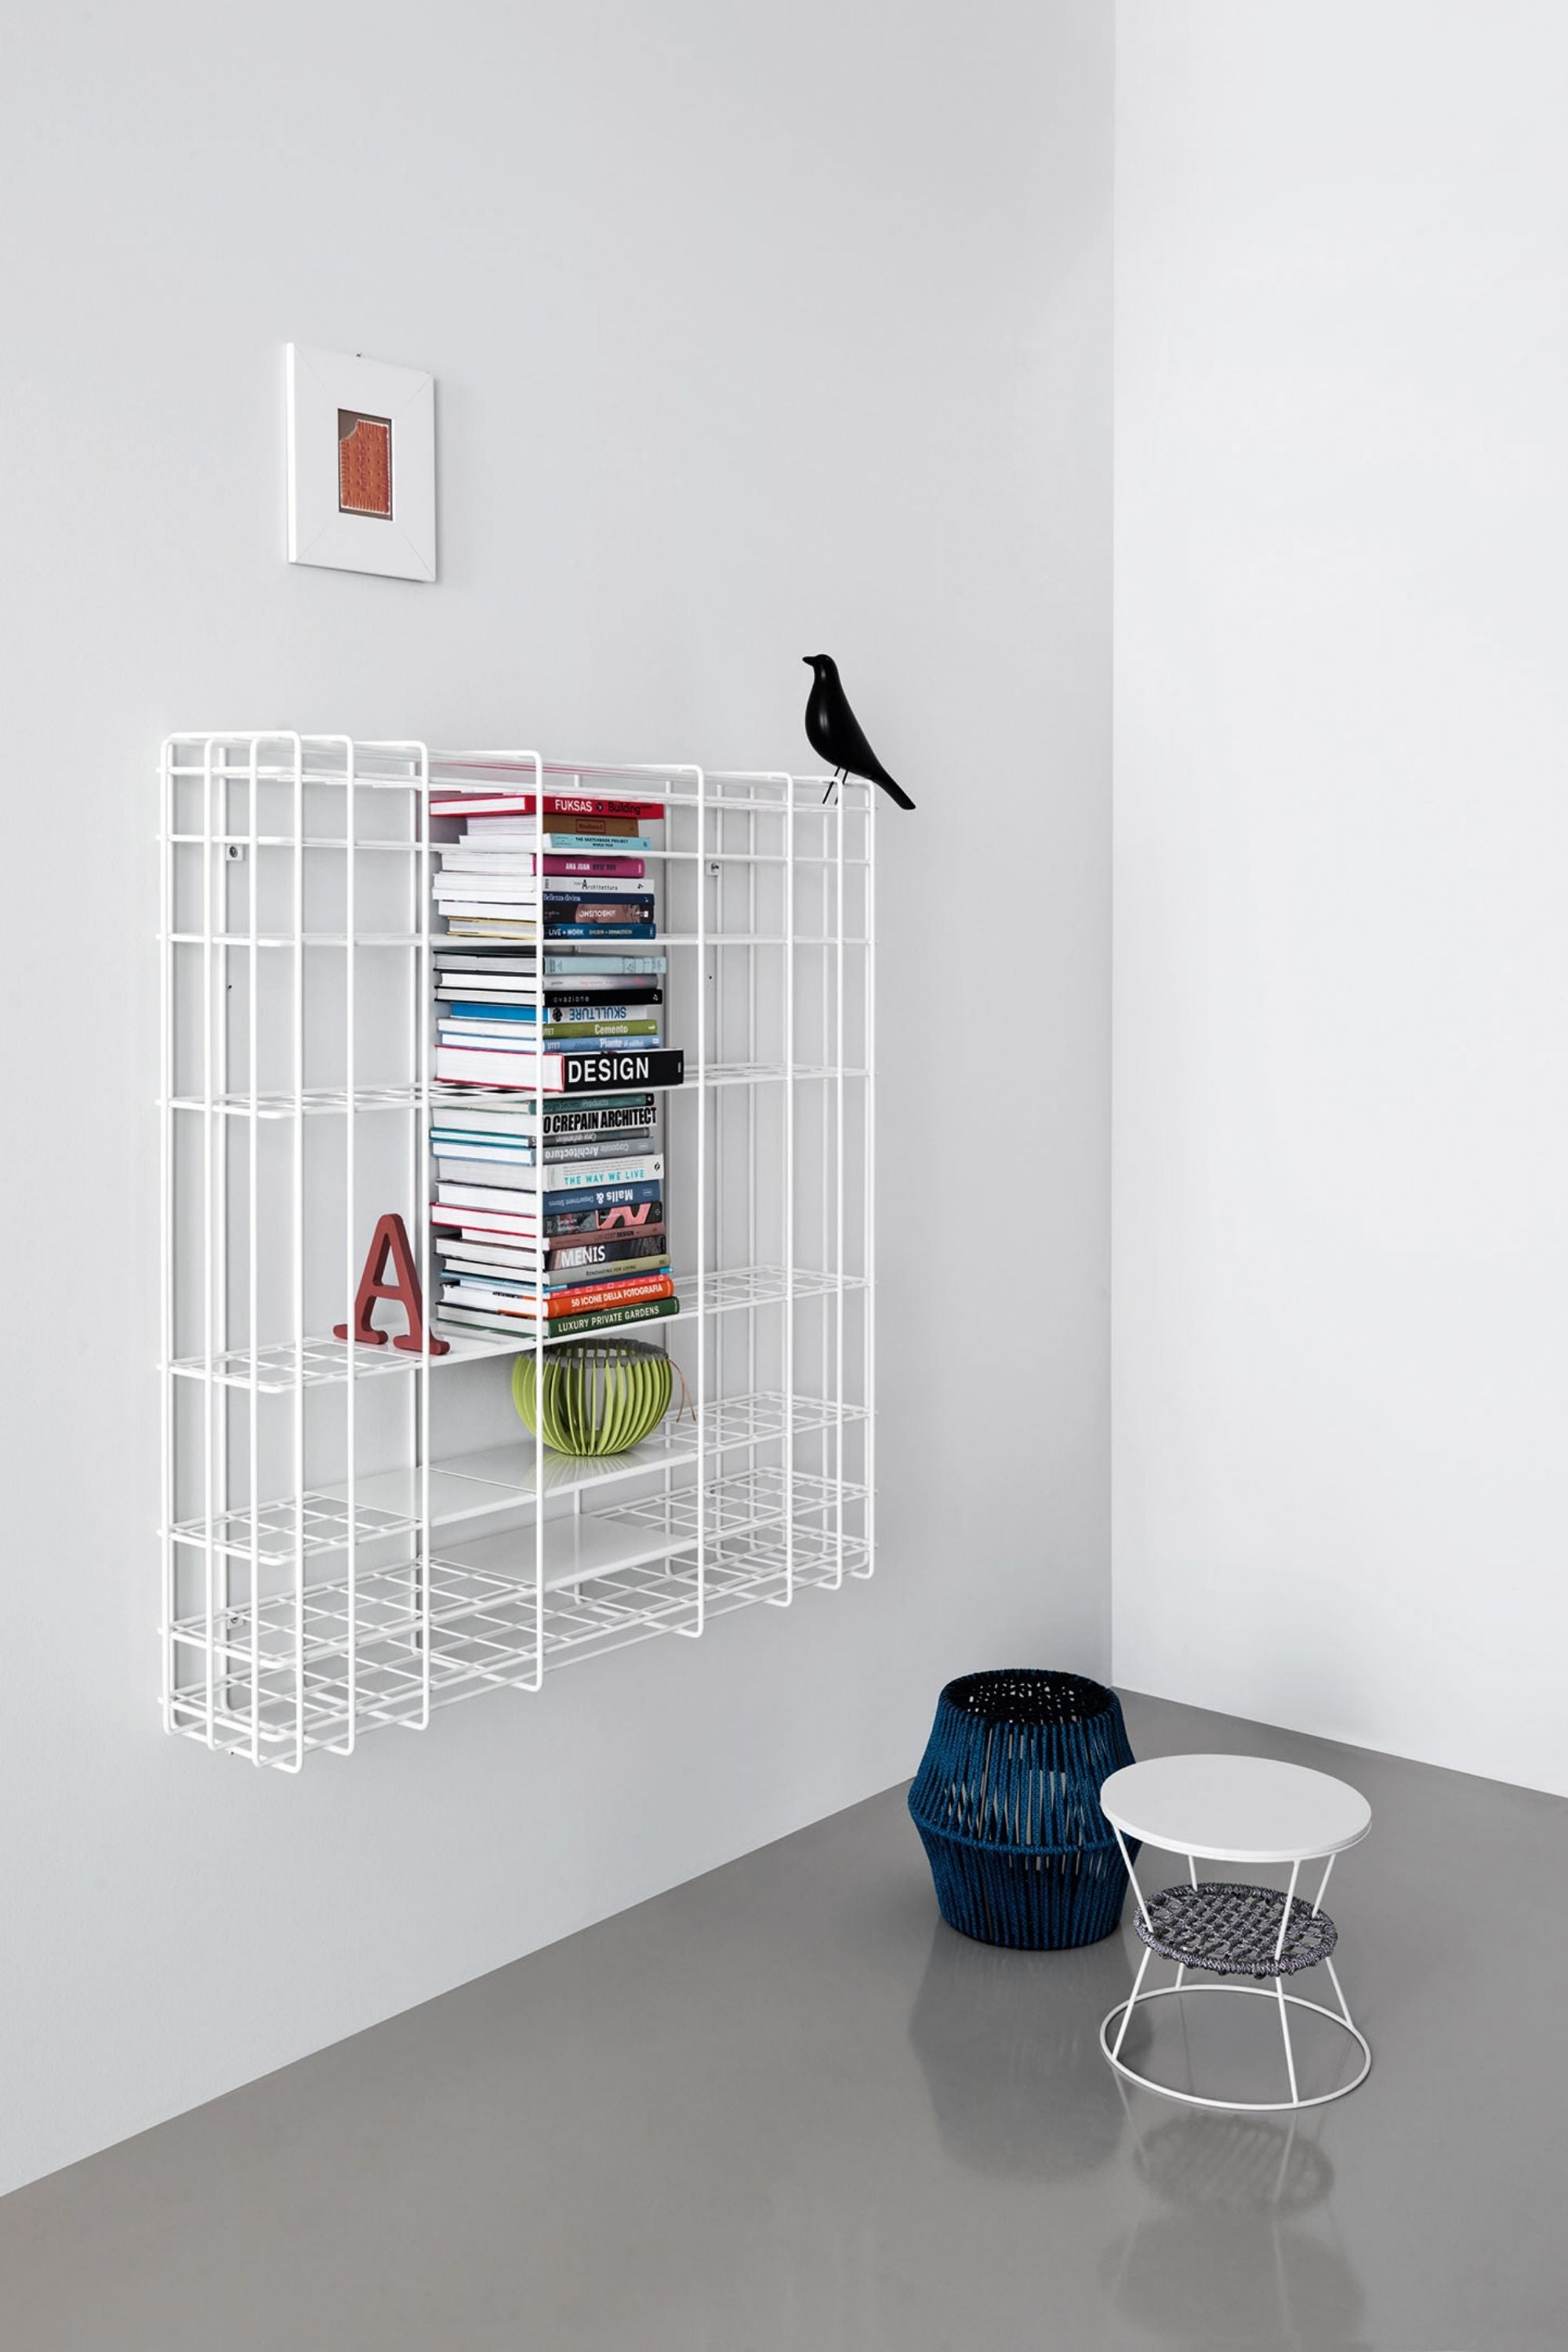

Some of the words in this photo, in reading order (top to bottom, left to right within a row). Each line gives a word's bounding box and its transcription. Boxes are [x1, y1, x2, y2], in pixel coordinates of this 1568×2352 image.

[555, 799, 593, 812] FUKSAS
[608, 801, 641, 815] Building
[568, 1007, 627, 1021] SKULLTURE
[594, 1024, 628, 1035] Cemento
[568, 1057, 649, 1083] DESIGN
[543, 1116, 551, 1134] O
[554, 1112, 598, 1134] CREPAIN
[600, 1107, 657, 1129] ARCHITECT
[545, 1145, 599, 1160] Architecture
[564, 1176, 581, 1185] THE
[586, 1174, 604, 1183] WAY
[608, 1171, 621, 1181] WE
[626, 1169, 644, 1178] LIVE
[566, 1196, 593, 1205] Department
[596, 1192, 604, 1204] &
[606, 1189, 633, 1202] Malls
[616, 1230, 634, 1239] DESIGN
[561, 1245, 606, 1268] MENIS
[333, 1214, 450, 1356] A
[571, 1298, 580, 1308] 50
[581, 1294, 603, 1305] ICONE
[604, 1291, 622, 1301] DELLA
[623, 1283, 663, 1298] FOTOGRAFIA
[558, 1319, 589, 1333] LUXURY
[591, 1313, 622, 1327] PRIVATE
[625, 1305, 659, 1319] GARDENS
